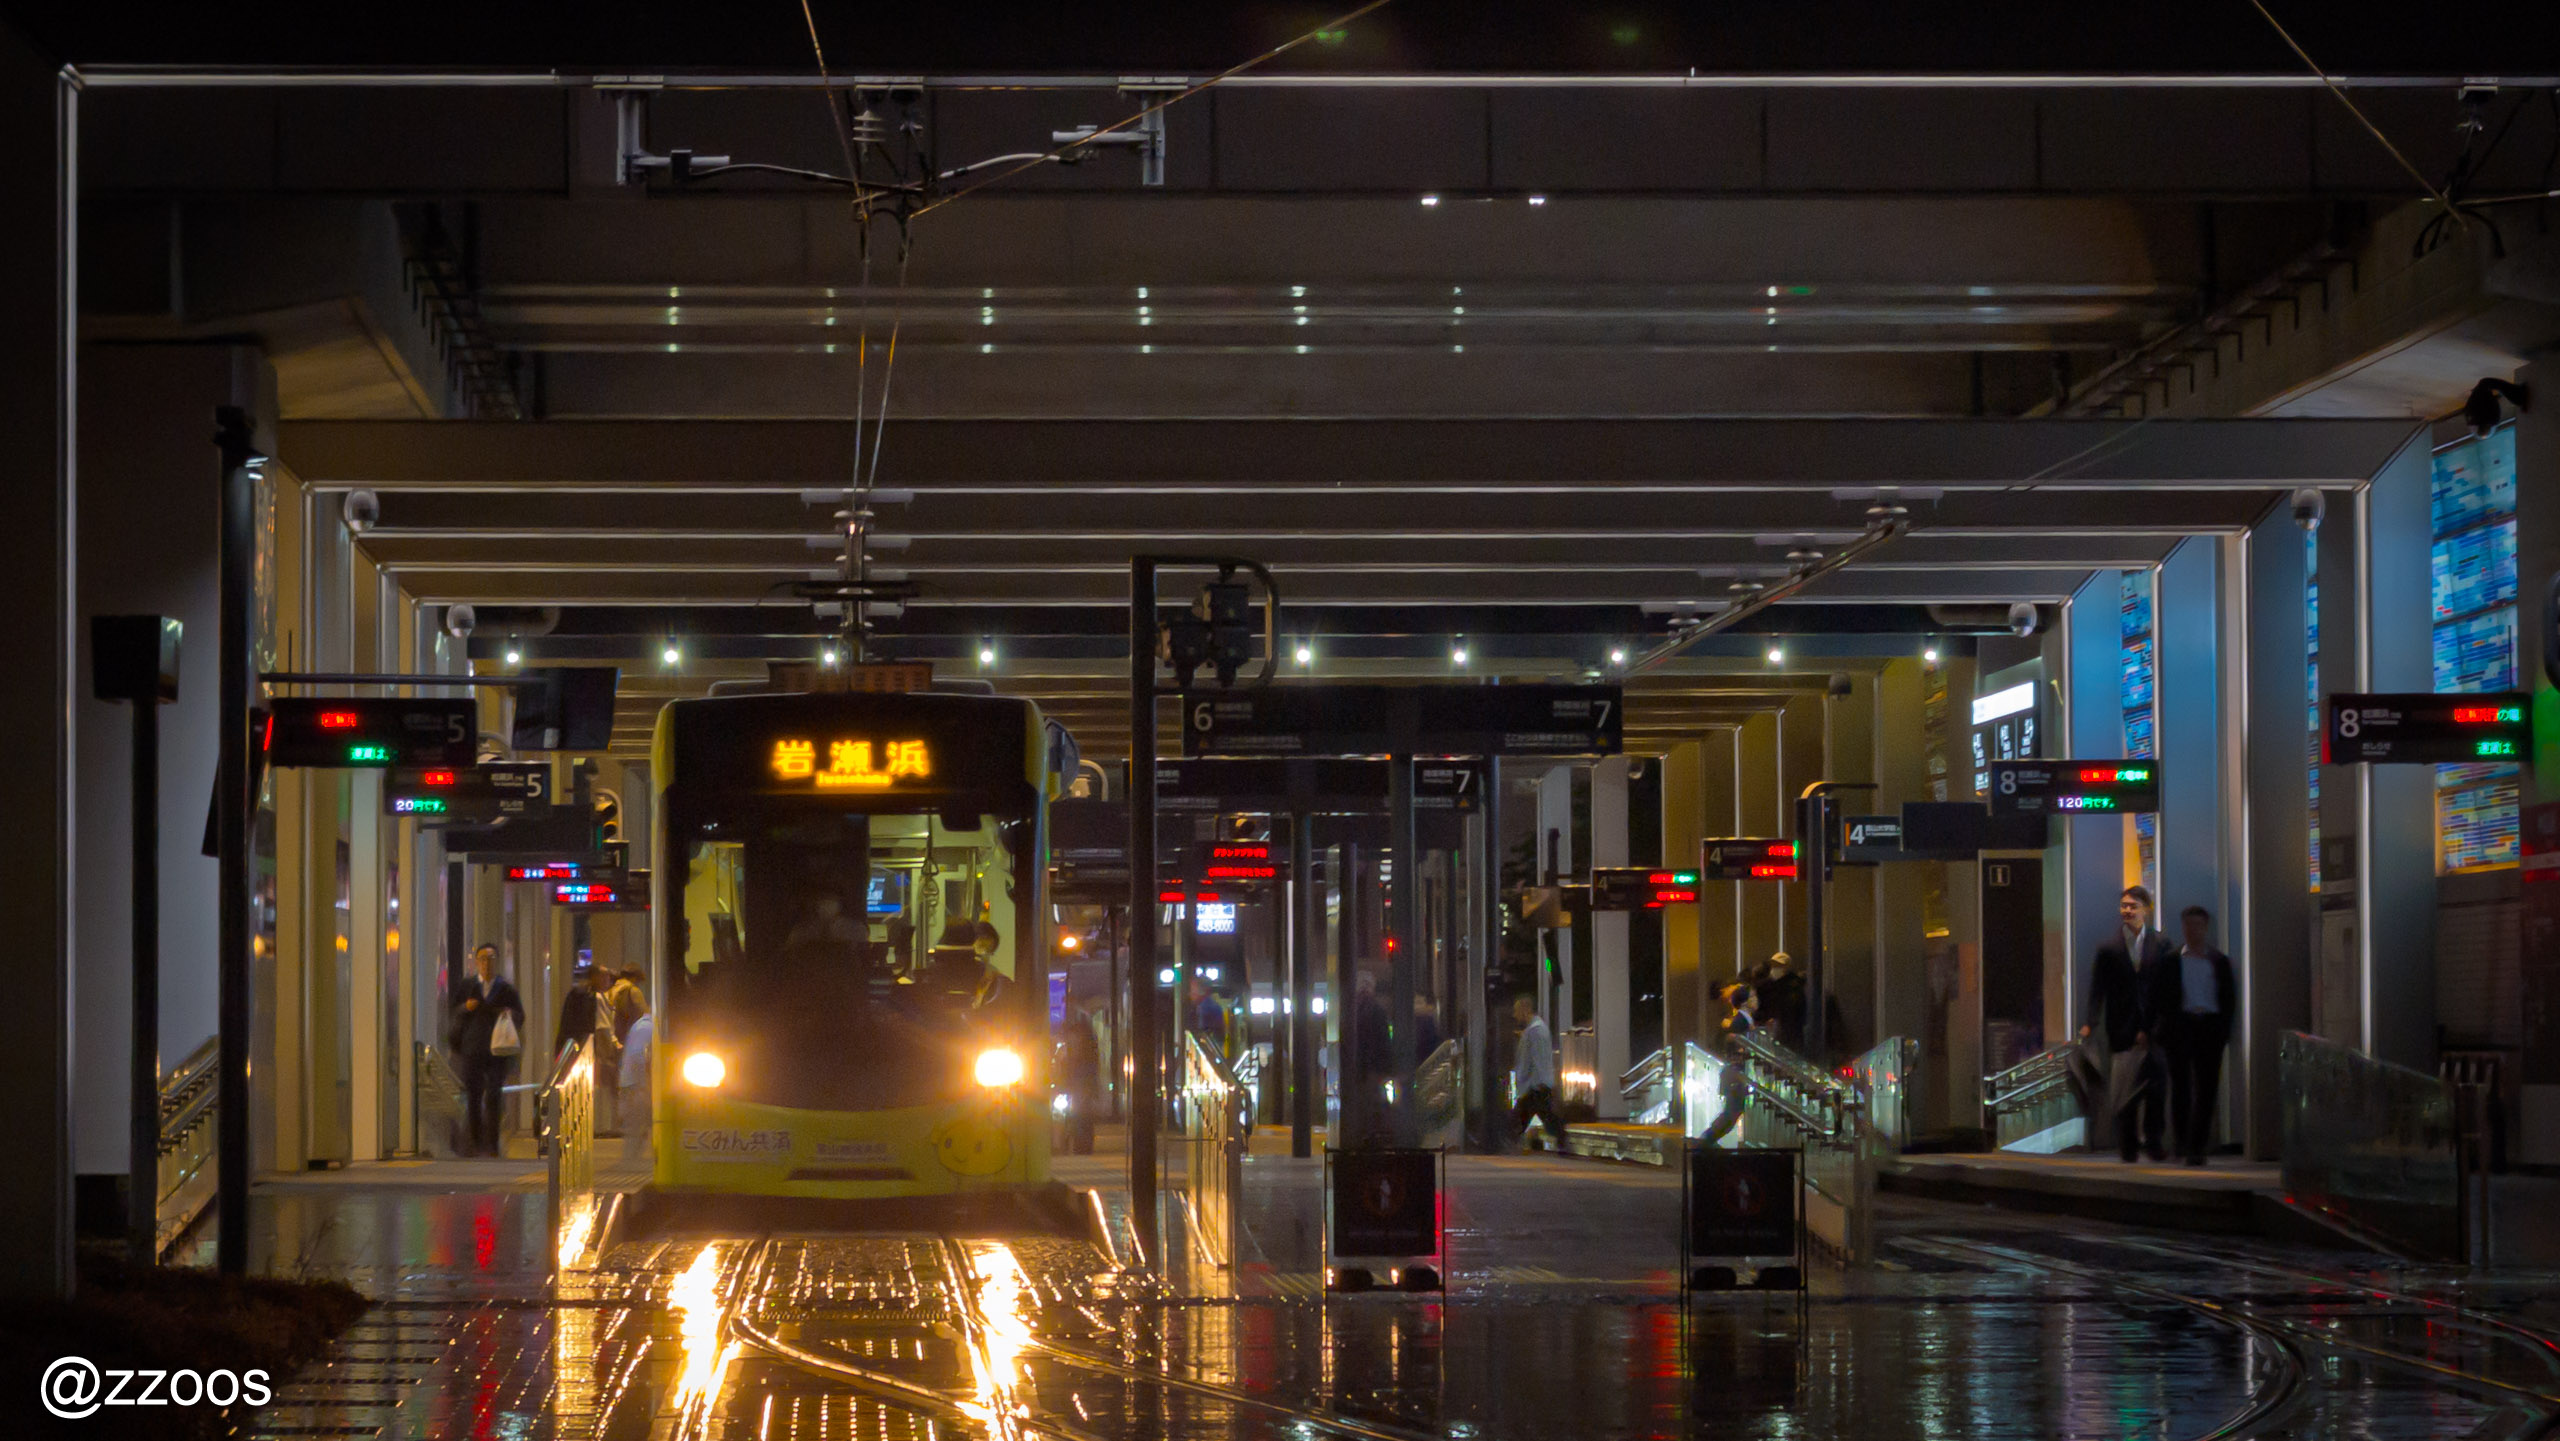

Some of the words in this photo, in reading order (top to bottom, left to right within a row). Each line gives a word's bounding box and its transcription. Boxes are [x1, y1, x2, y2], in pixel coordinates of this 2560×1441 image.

[1193, 701, 1214, 732] 6
[1592, 699, 1612, 729] 7
[2339, 708, 2360, 738] 8
[447, 714, 465, 743] 5
[774, 739, 929, 776] 岩瀬浜
[526, 773, 542, 798] 5
[1455, 769, 1471, 794] 7
[1999, 770, 2017, 795] 8
[1849, 823, 1866, 845] 4
[1709, 846, 1724, 866] 4
[682, 1129, 793, 1152] こくみん共済
